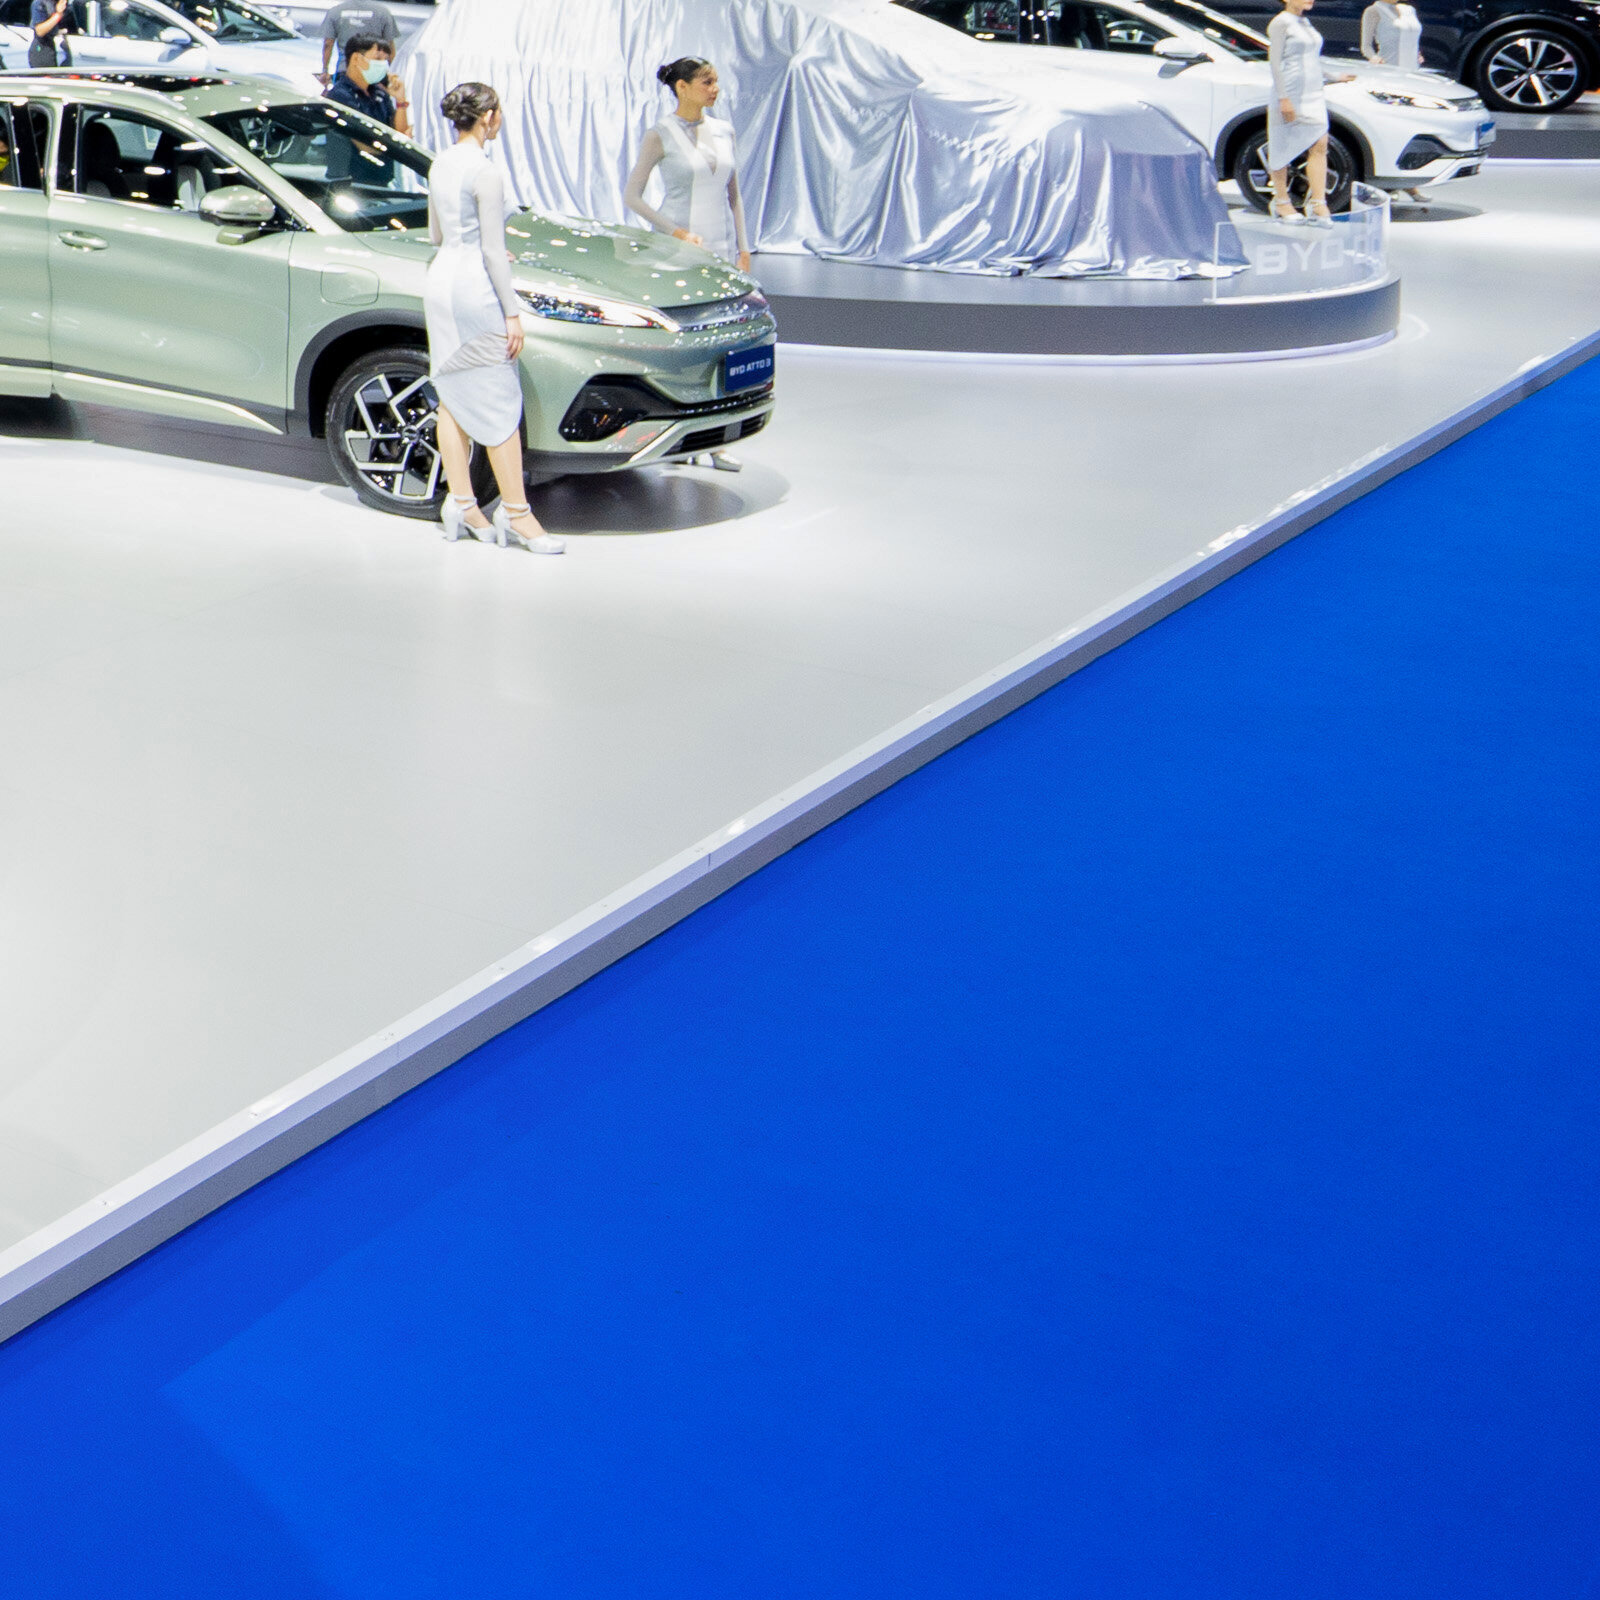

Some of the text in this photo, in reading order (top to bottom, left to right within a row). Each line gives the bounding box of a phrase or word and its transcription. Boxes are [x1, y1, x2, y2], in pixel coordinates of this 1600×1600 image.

[1256, 238, 1344, 276] BYD
[730, 364, 746, 377] BYD
[746, 359, 765, 372] ATTO
